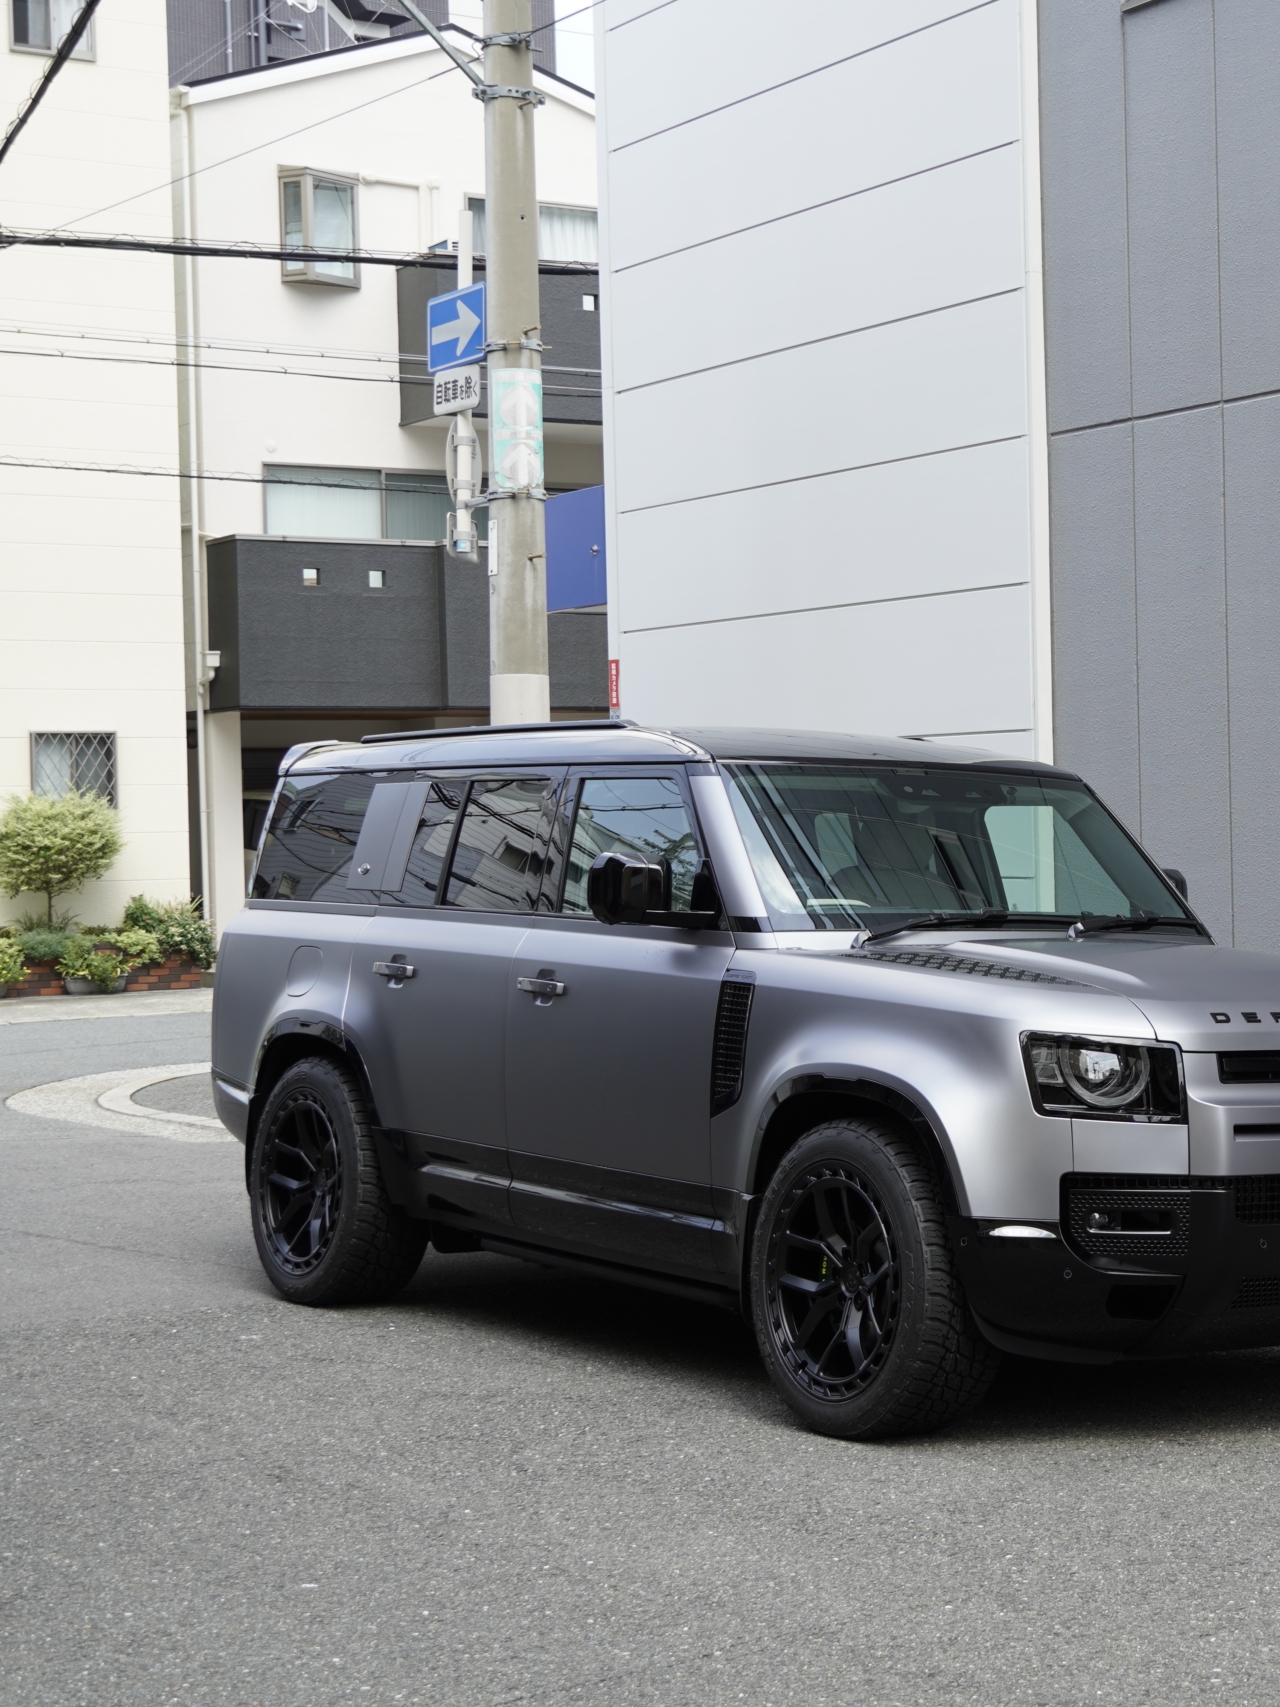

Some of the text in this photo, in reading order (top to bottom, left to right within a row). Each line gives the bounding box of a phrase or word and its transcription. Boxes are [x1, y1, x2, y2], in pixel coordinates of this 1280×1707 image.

[436, 375, 477, 405] 自転車を除く
